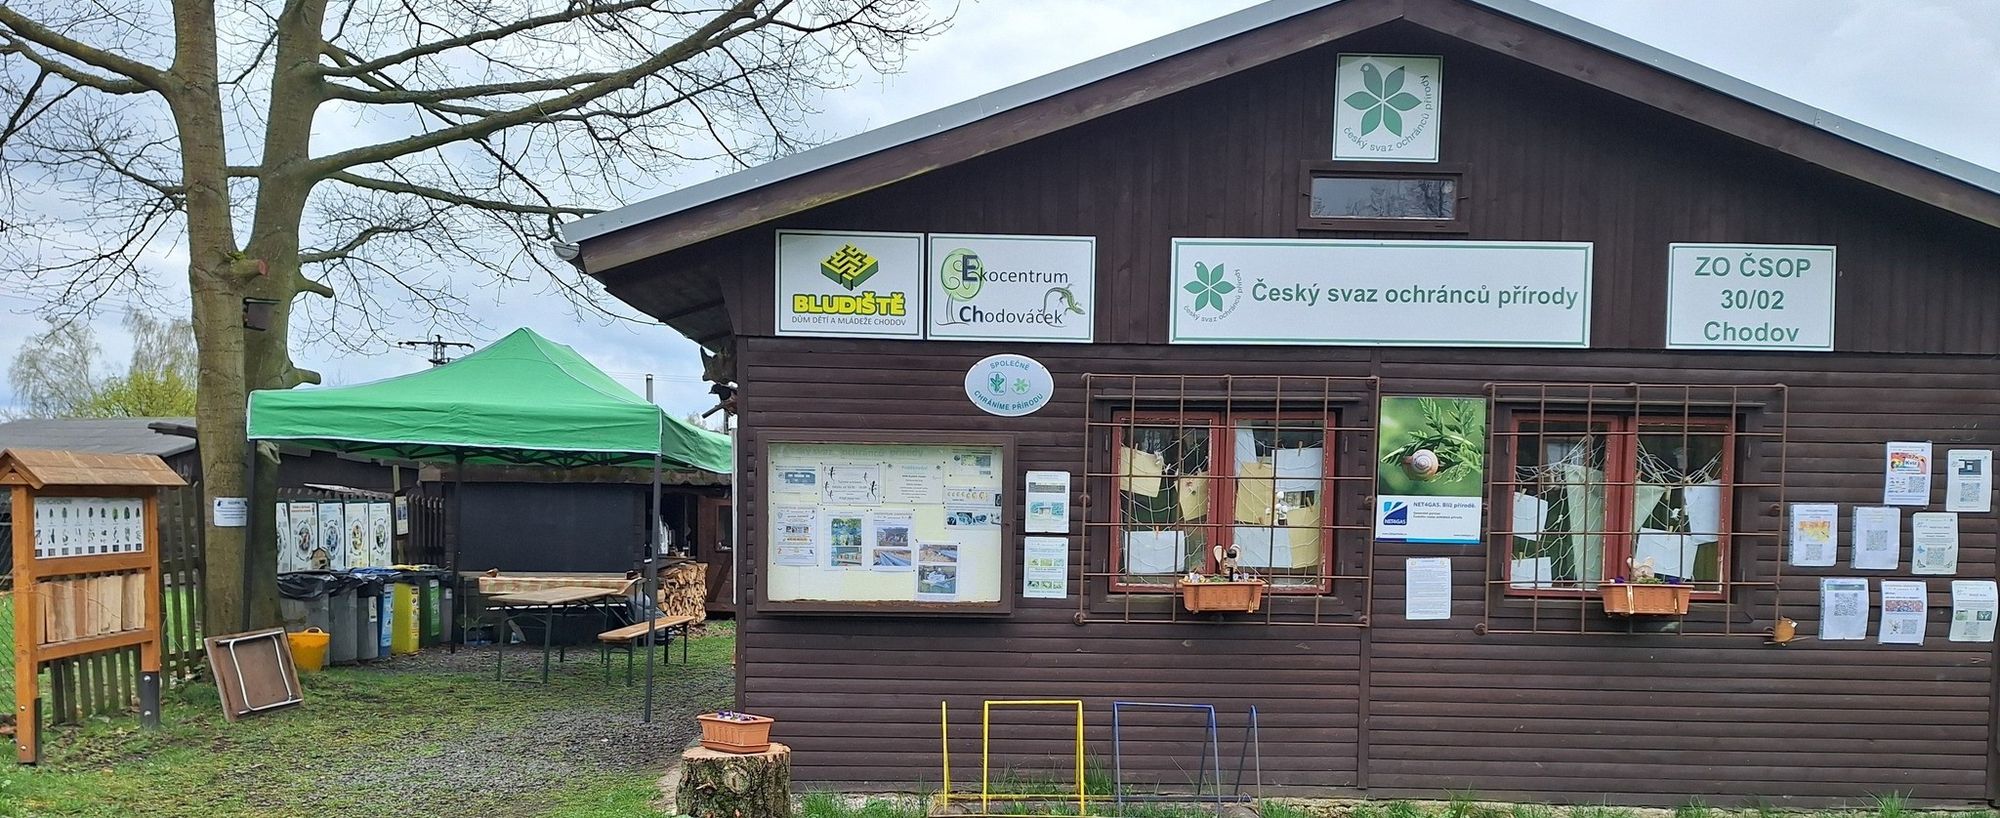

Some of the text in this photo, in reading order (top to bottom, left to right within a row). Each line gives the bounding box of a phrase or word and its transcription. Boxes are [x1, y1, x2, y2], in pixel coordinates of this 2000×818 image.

[1343, 74, 1433, 152] český svaz ochránců přírody
[962, 255, 1069, 283] Ekocentrum
[1694, 252, 1811, 278] ZO ČSOP
[793, 291, 906, 316] BLUDIŠTĚ
[1252, 278, 1578, 310] Český svaz ochránců přírody
[1720, 289, 1785, 310] 30/02
[792, 315, 810, 323] DŮM
[812, 315, 829, 324] DĚTÍ
[837, 316, 872, 325] MLÁDEŽE
[874, 318, 907, 326] CHODOV
[959, 305, 1063, 323] Chodováček
[1703, 321, 1800, 342] Chodov
[974, 390, 1043, 410] CHRÁNÍME PŘÍRODU
